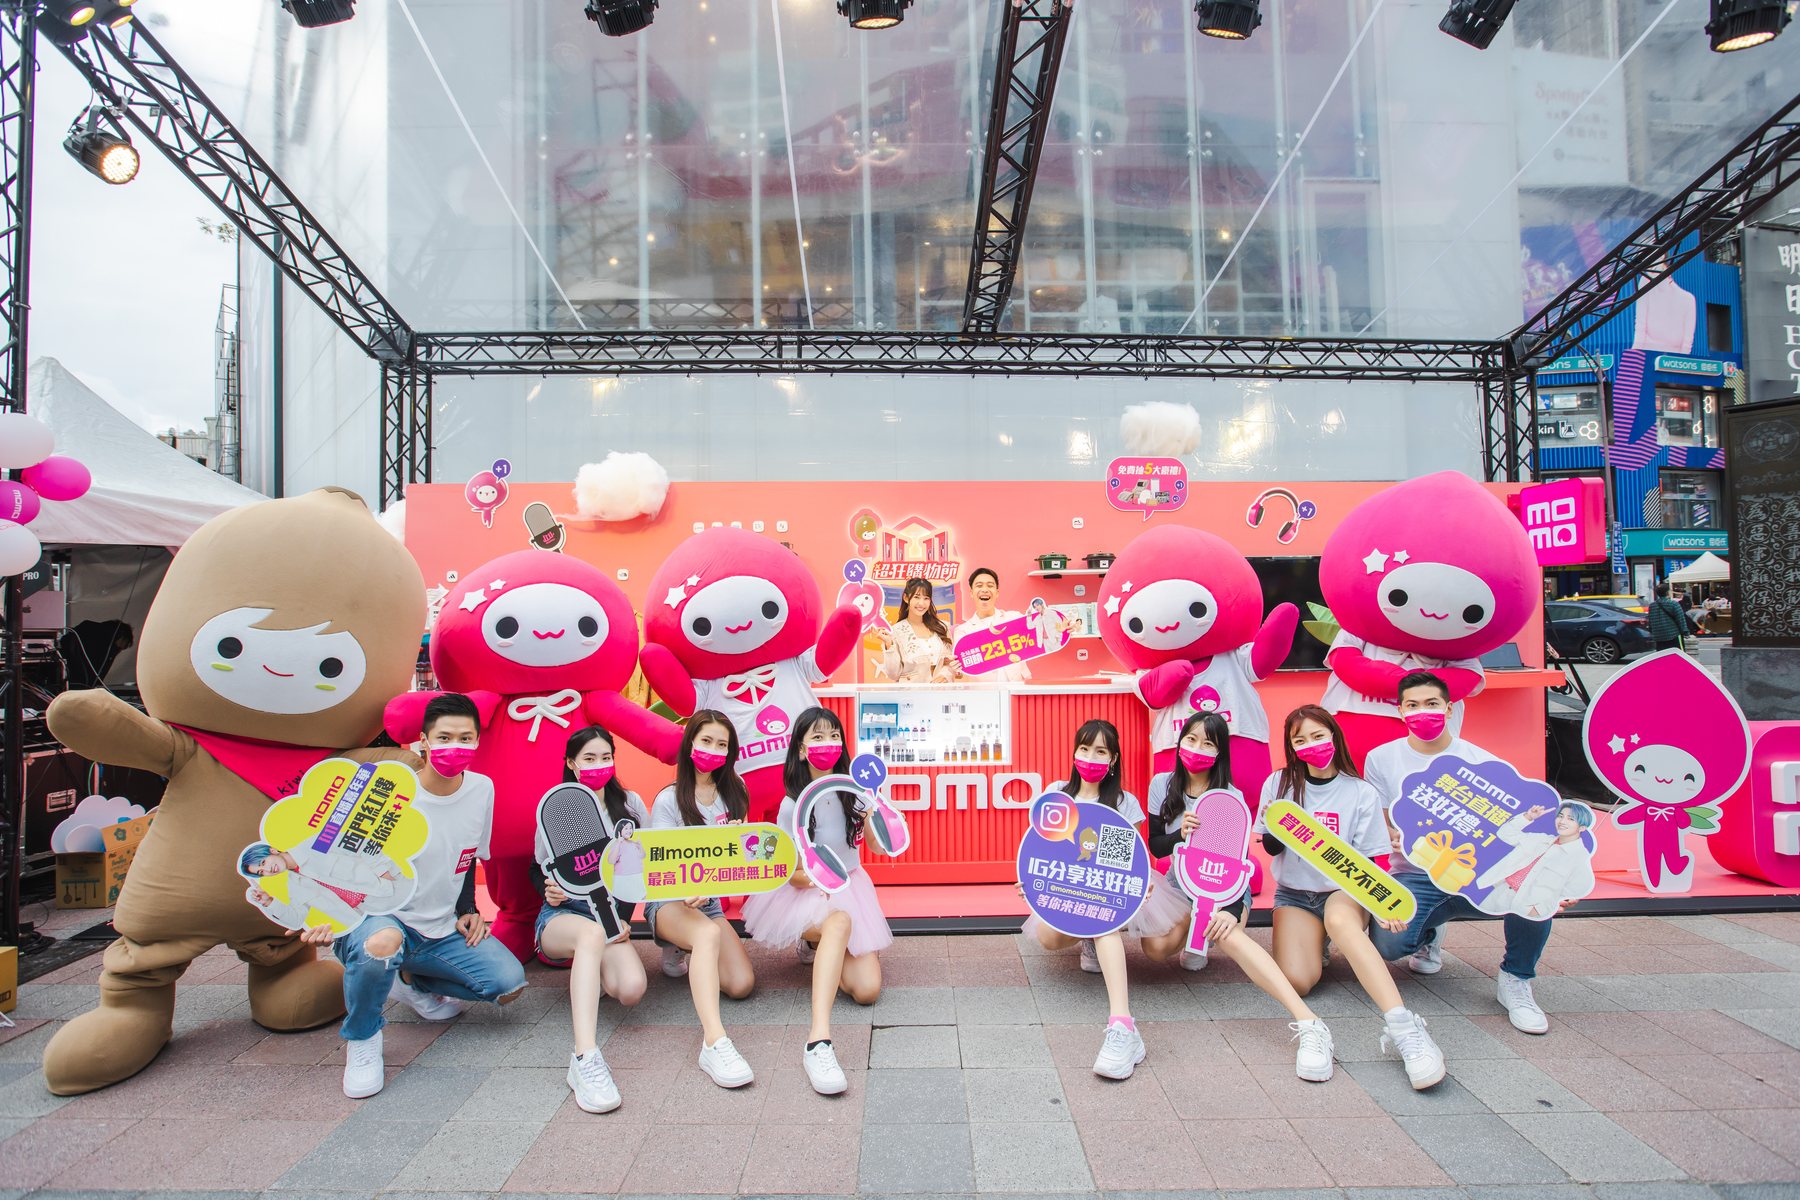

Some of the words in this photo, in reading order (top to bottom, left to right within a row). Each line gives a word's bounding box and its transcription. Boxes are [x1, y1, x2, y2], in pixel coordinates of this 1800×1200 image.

[1662, 359, 1698, 371] watsons
[1668, 537, 1706, 546] watsons
[23, 571, 40, 580] PRO
[873, 562, 960, 581] 超狂購物節
[980, 634, 1035, 662] 23.5%
[858, 761, 882, 781] +1
[881, 772, 1042, 811] omo
[1433, 773, 1513, 827] 舞台直播
[1456, 766, 1521, 810] momo
[308, 775, 346, 828] momo
[338, 776, 397, 853] 西門紅樓
[650, 842, 739, 862] 刷momo卡
[648, 862, 788, 887] 最高10%回饋無上限
[1027, 857, 1144, 897] IG分享送好禮
[1200, 874, 1222, 885] momo
